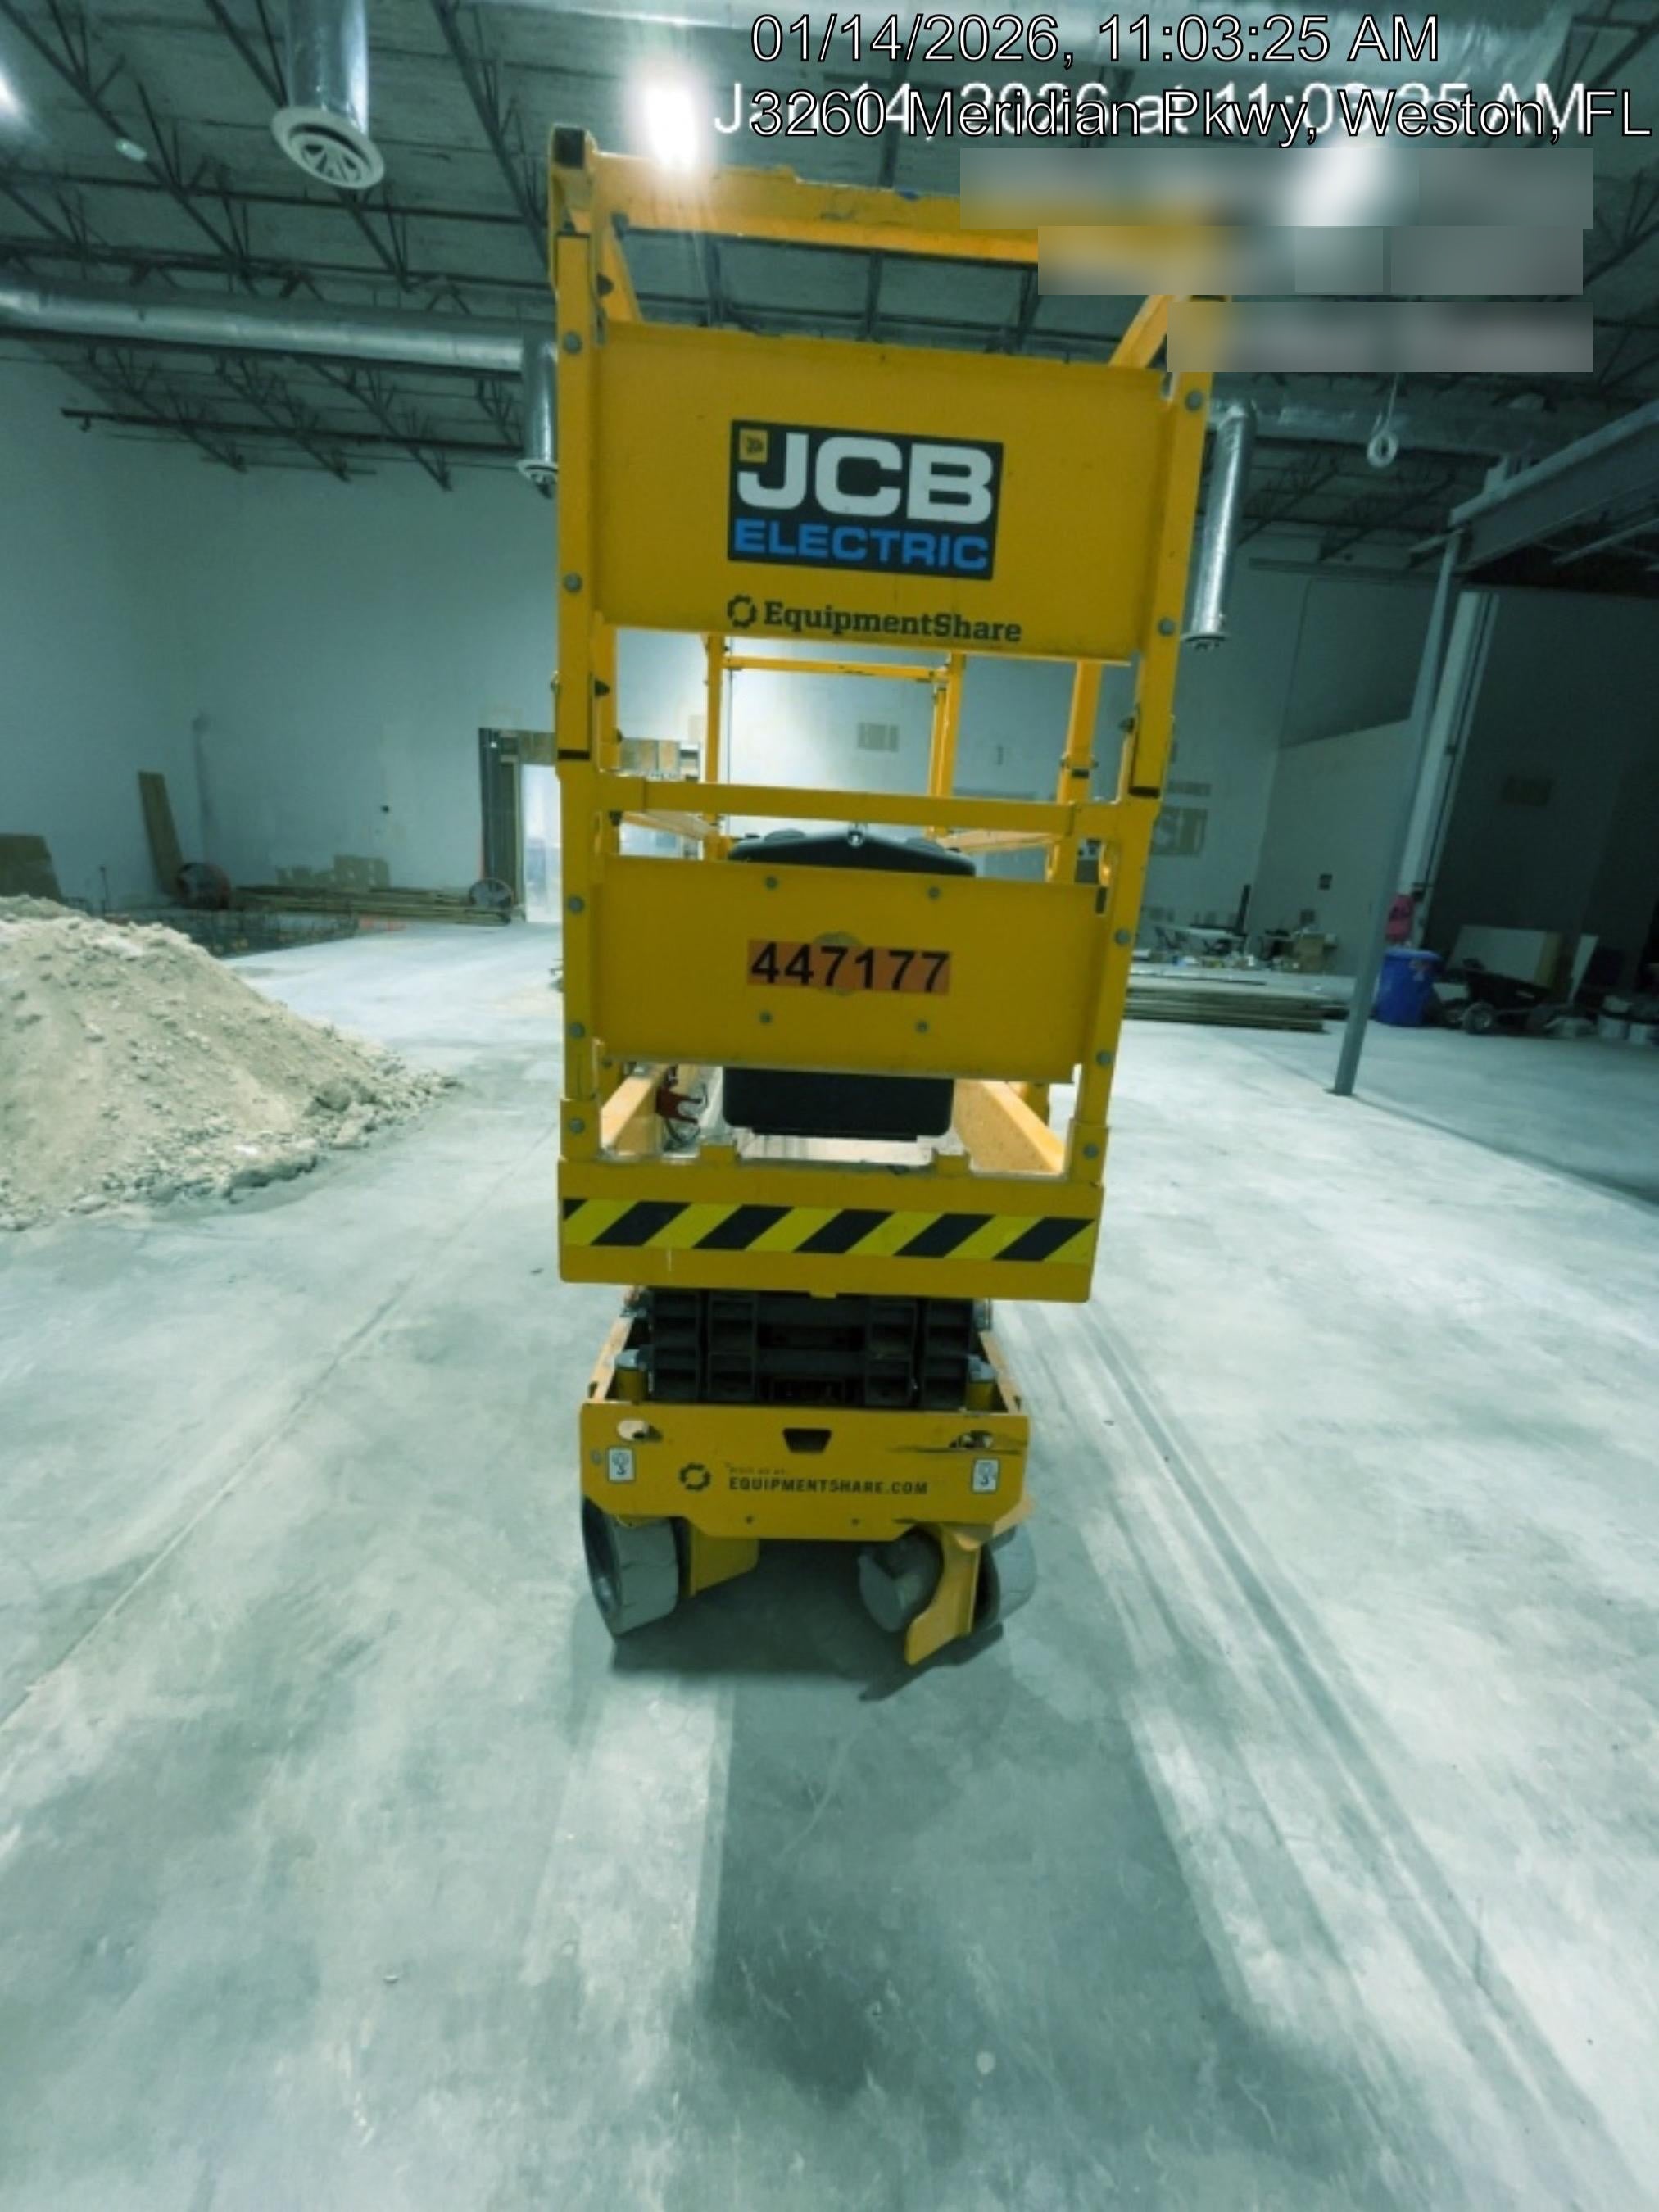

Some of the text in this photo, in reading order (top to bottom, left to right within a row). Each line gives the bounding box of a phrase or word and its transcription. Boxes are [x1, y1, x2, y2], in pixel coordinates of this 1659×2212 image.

[737, 431, 994, 524] JCB
[734, 518, 990, 570] ELECTRIC
[763, 601, 1022, 642] EquipmentShare
[751, 941, 950, 993] 447177
[728, 1476, 928, 1495] EQUIPMENTSHARE.COM
